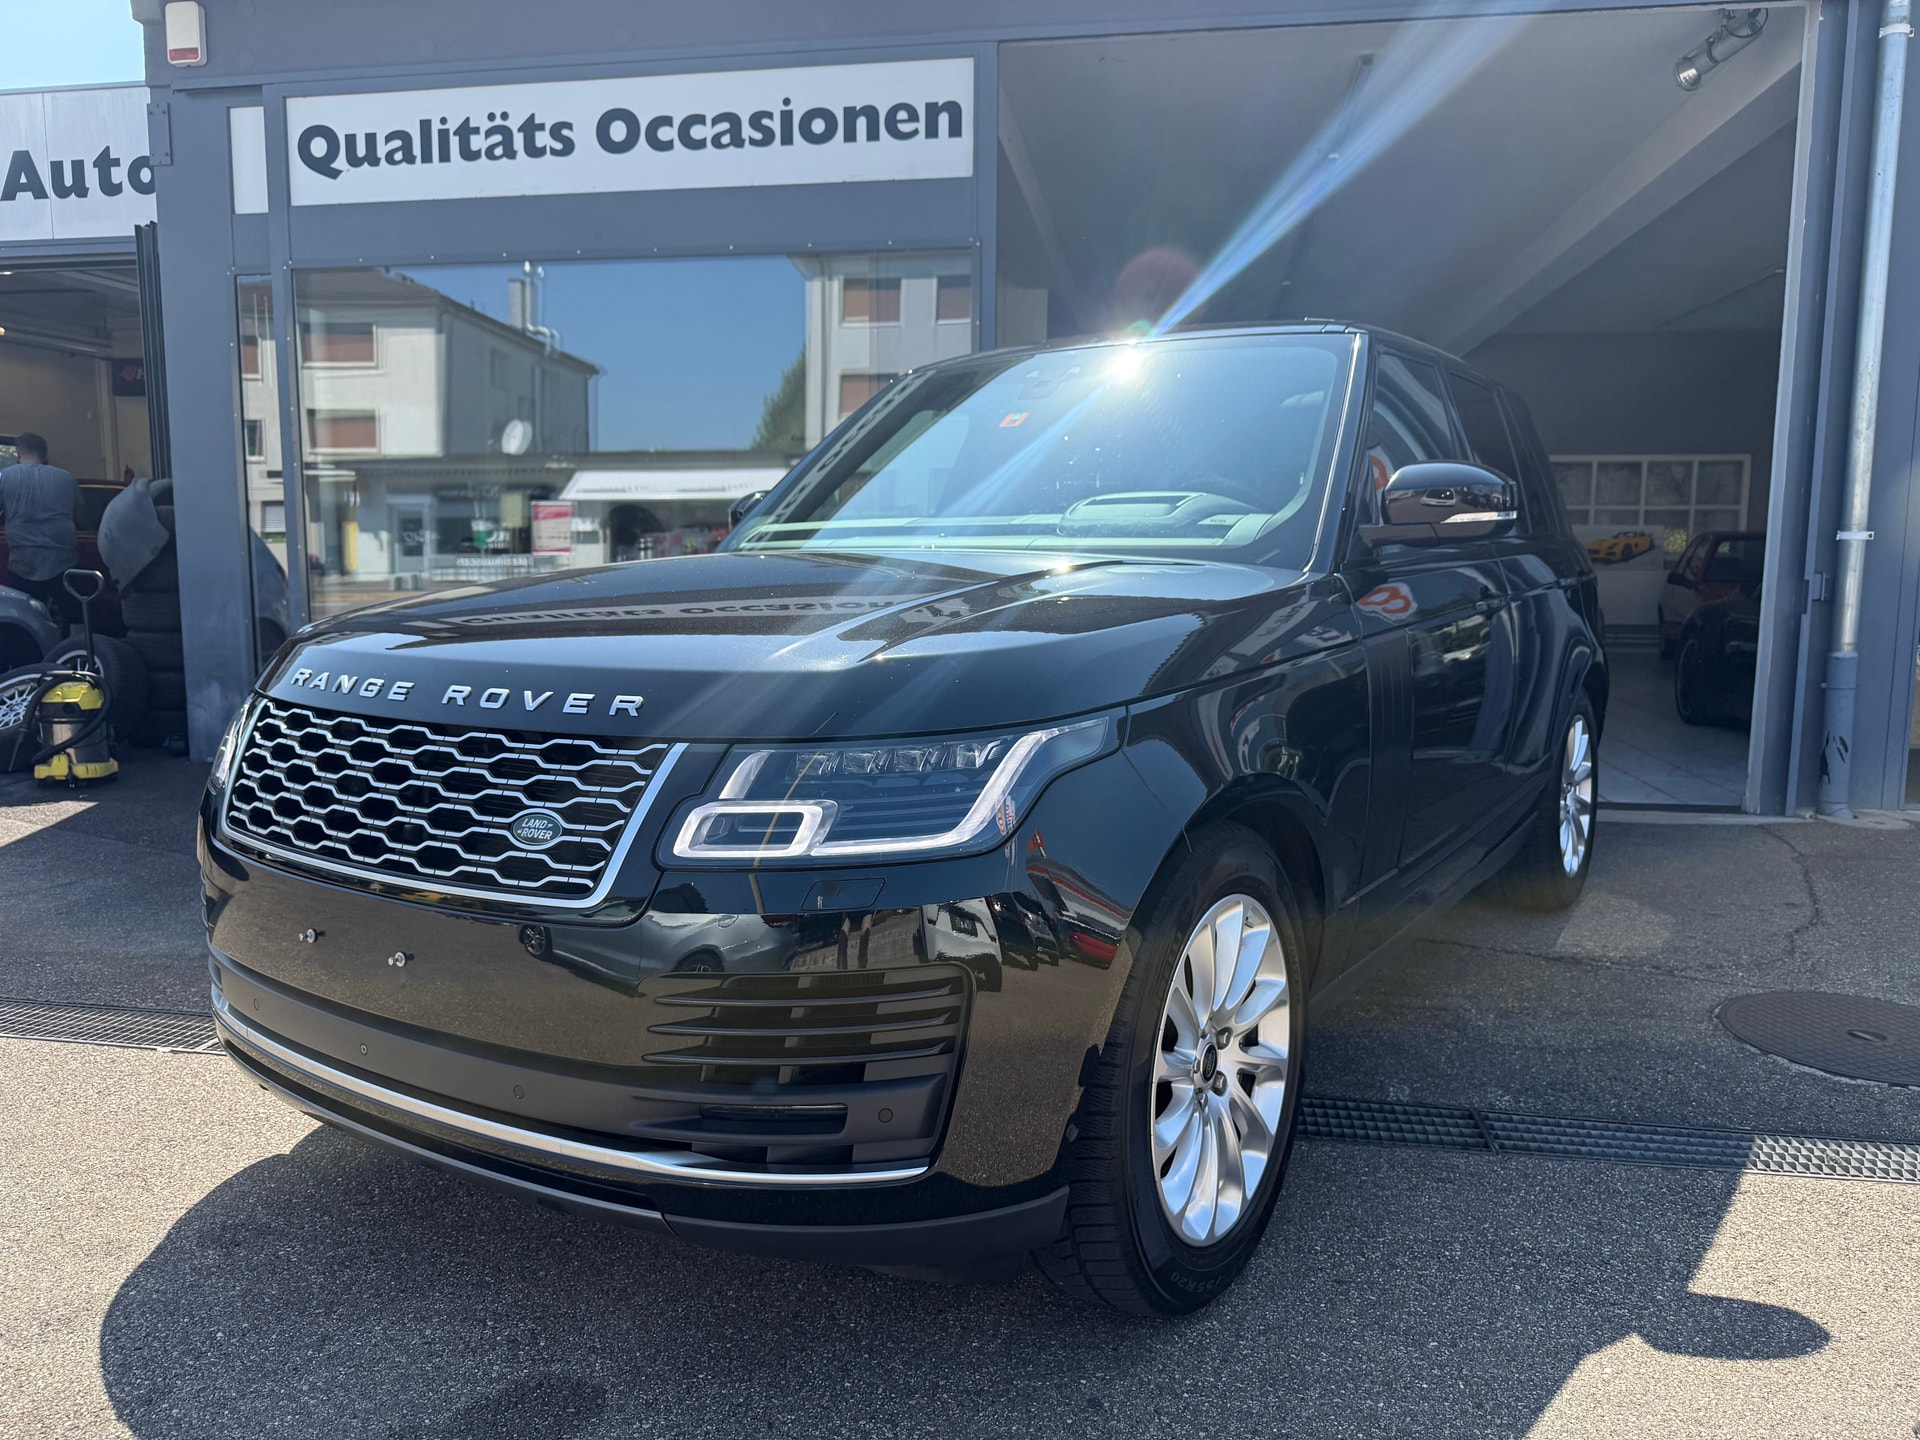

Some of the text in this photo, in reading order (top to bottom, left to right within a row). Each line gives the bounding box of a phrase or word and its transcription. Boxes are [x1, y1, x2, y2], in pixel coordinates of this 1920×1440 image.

[298, 97, 963, 180] Qualitäts Occasionen
[0, 145, 157, 201] Auto
[290, 667, 645, 717] RANGE ROVER
[520, 828, 553, 840] ROVER
[521, 818, 548, 829] LAND
